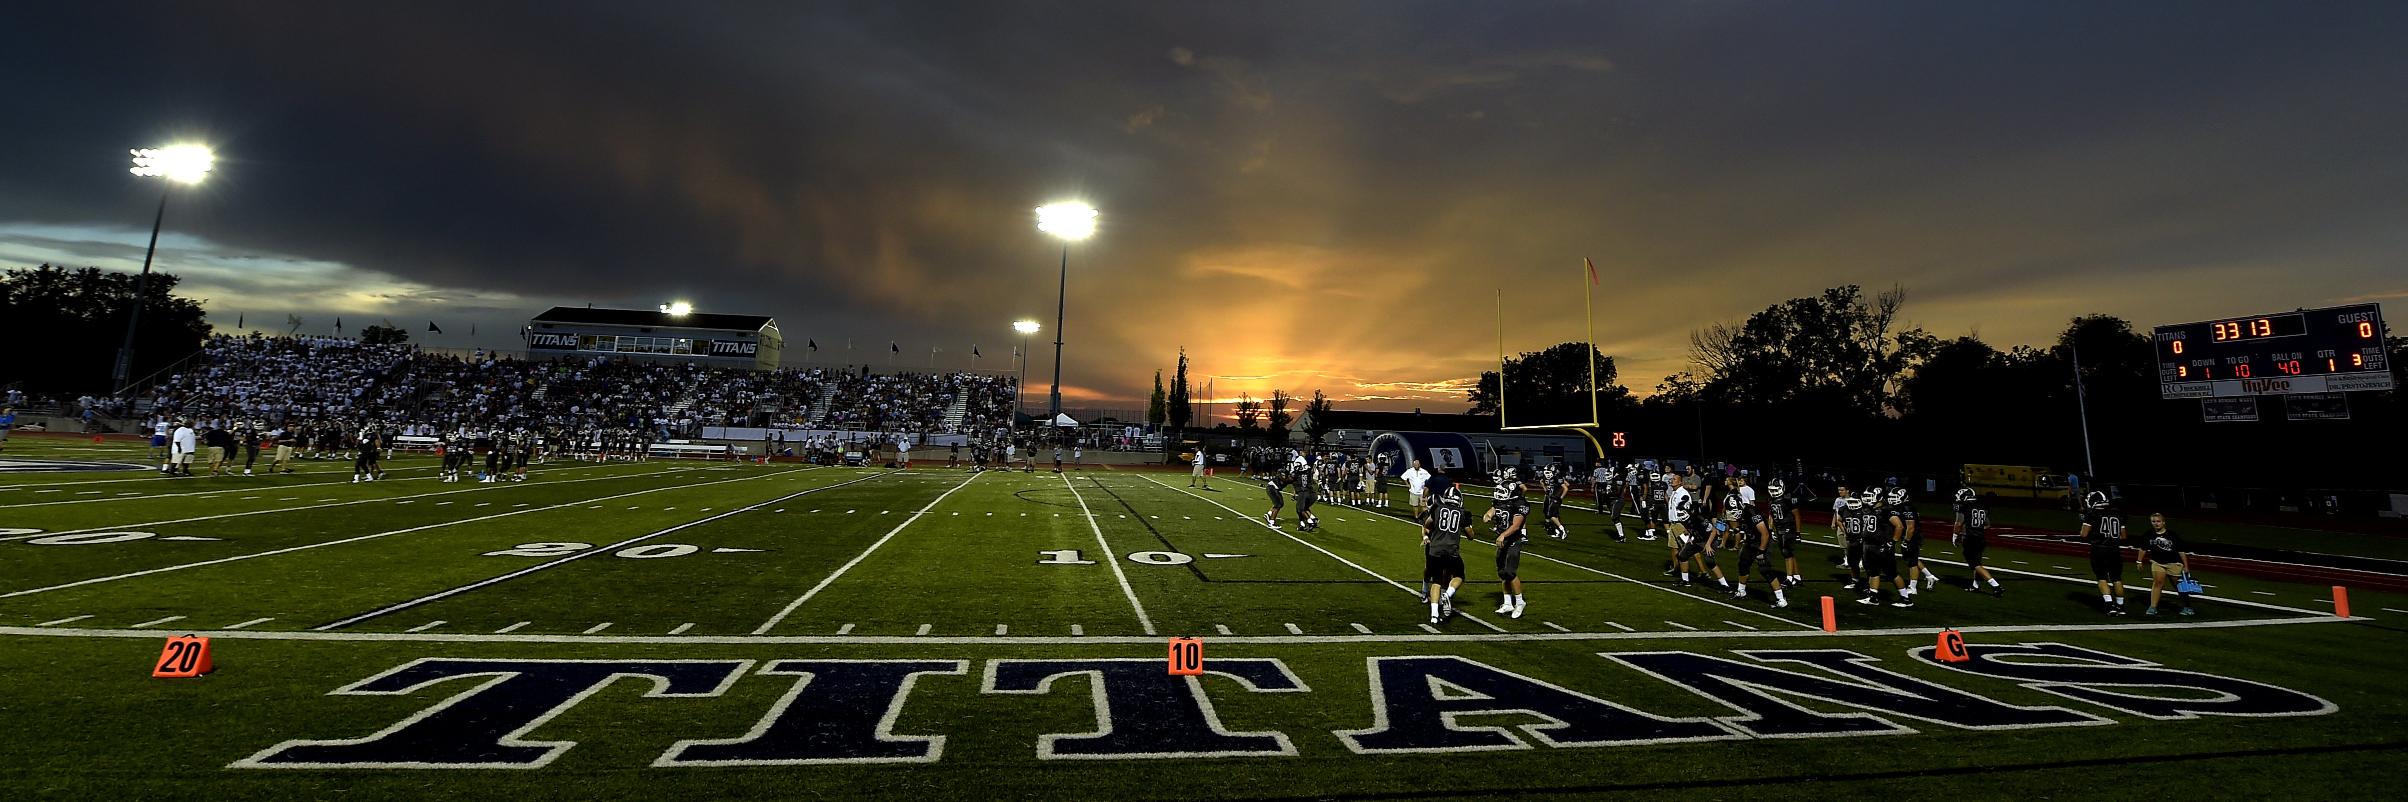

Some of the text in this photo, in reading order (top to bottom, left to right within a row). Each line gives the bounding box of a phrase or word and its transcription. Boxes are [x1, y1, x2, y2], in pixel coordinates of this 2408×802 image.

[2338, 312, 2375, 324] GUEST
[2157, 331, 2186, 342] TITANS
[2359, 322, 2372, 338] 0
[532, 334, 578, 346] TITANS
[713, 342, 757, 354] TITANS
[2173, 340, 2183, 354] 0
[2317, 349, 2336, 358] QTR
[2192, 358, 2216, 367] DOWN
[2225, 355, 2249, 365] TO GO
[2271, 352, 2302, 362] BALL ON
[2352, 354, 2362, 366] 3
[2362, 354, 2383, 362] OUTS
[2235, 364, 2250, 377] 10
[2278, 360, 2300, 375] 40
[2329, 358, 2335, 371] 1
[2364, 361, 2383, 370] LEFT
[2178, 366, 2187, 377] 3
[1613, 433, 1625, 447] 25
[1438, 508, 1461, 533] 80
[1845, 517, 1861, 534] 76
[2100, 516, 2120, 539] 40
[1947, 634, 1966, 657] G
[159, 641, 202, 672] 20
[1172, 642, 1200, 671] 10
[225, 641, 2340, 769] TITANS
